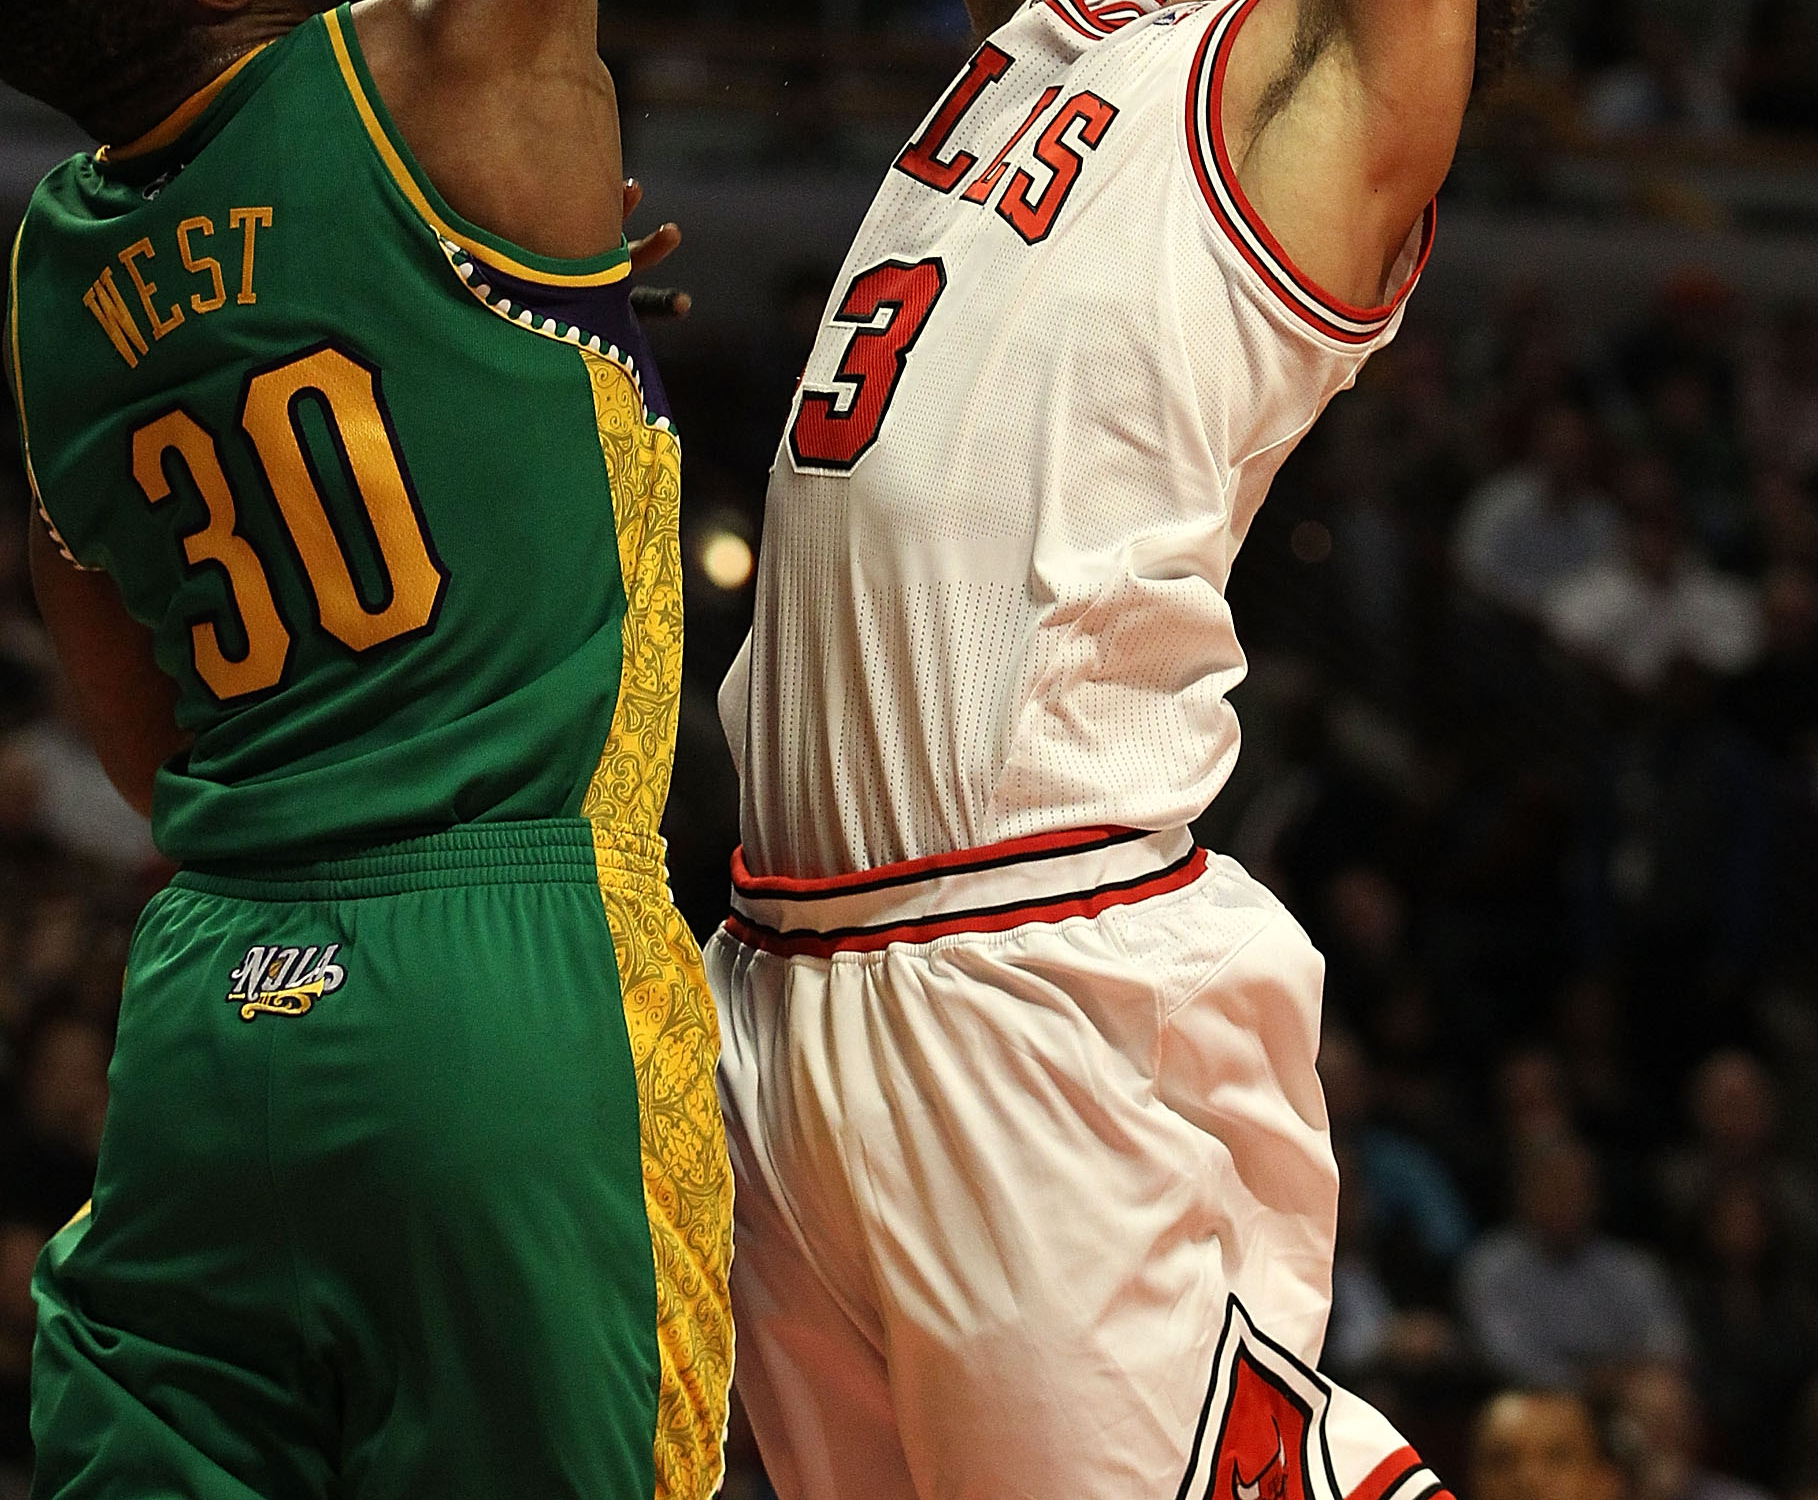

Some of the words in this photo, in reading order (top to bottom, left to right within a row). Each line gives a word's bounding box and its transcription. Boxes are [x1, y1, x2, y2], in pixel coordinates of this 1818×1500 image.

[82, 205, 274, 369] WEST
[788, 256, 948, 471] 3
[127, 336, 453, 704] 30
